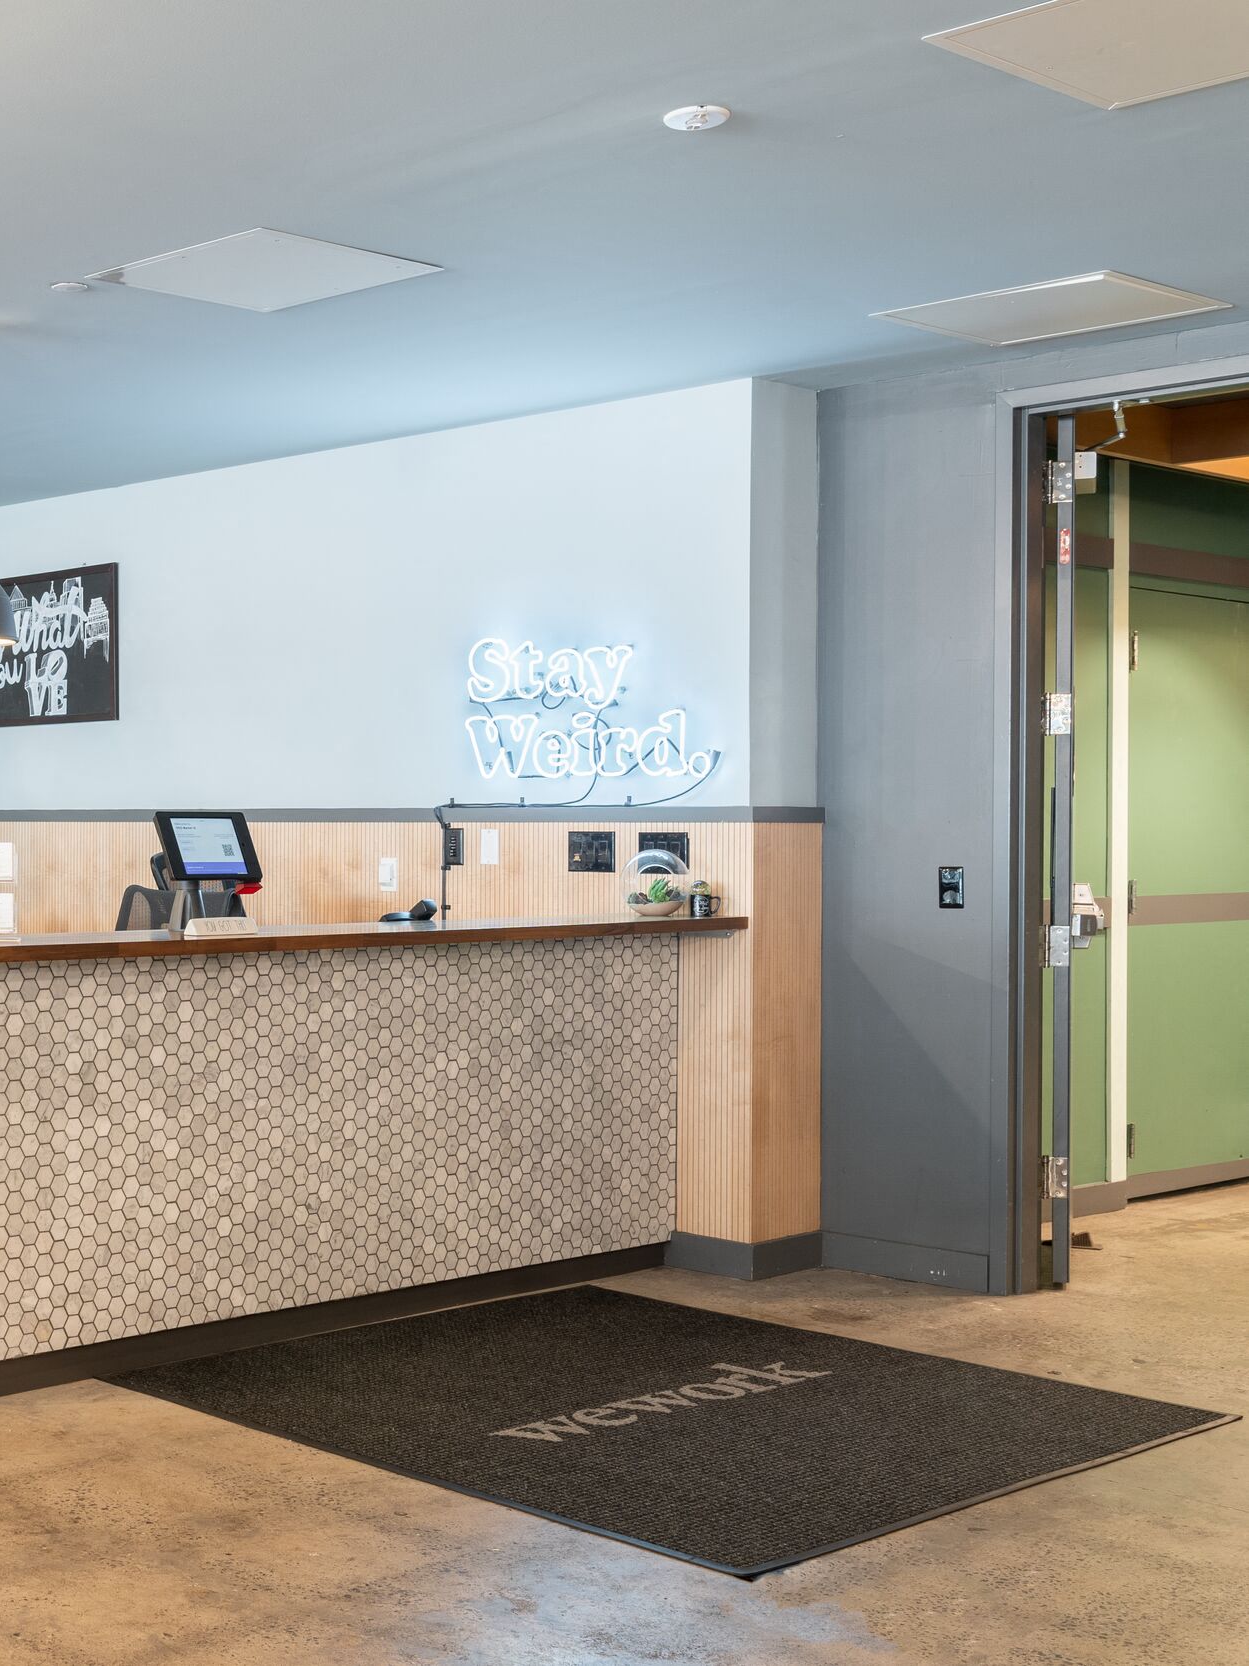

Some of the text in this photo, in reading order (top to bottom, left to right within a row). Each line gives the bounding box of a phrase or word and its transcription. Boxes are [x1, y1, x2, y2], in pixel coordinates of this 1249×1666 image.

[12, 586, 87, 655] What
[467, 638, 633, 709] Stay
[465, 708, 711, 779] Weird.
[488, 1361, 833, 1442] wework
